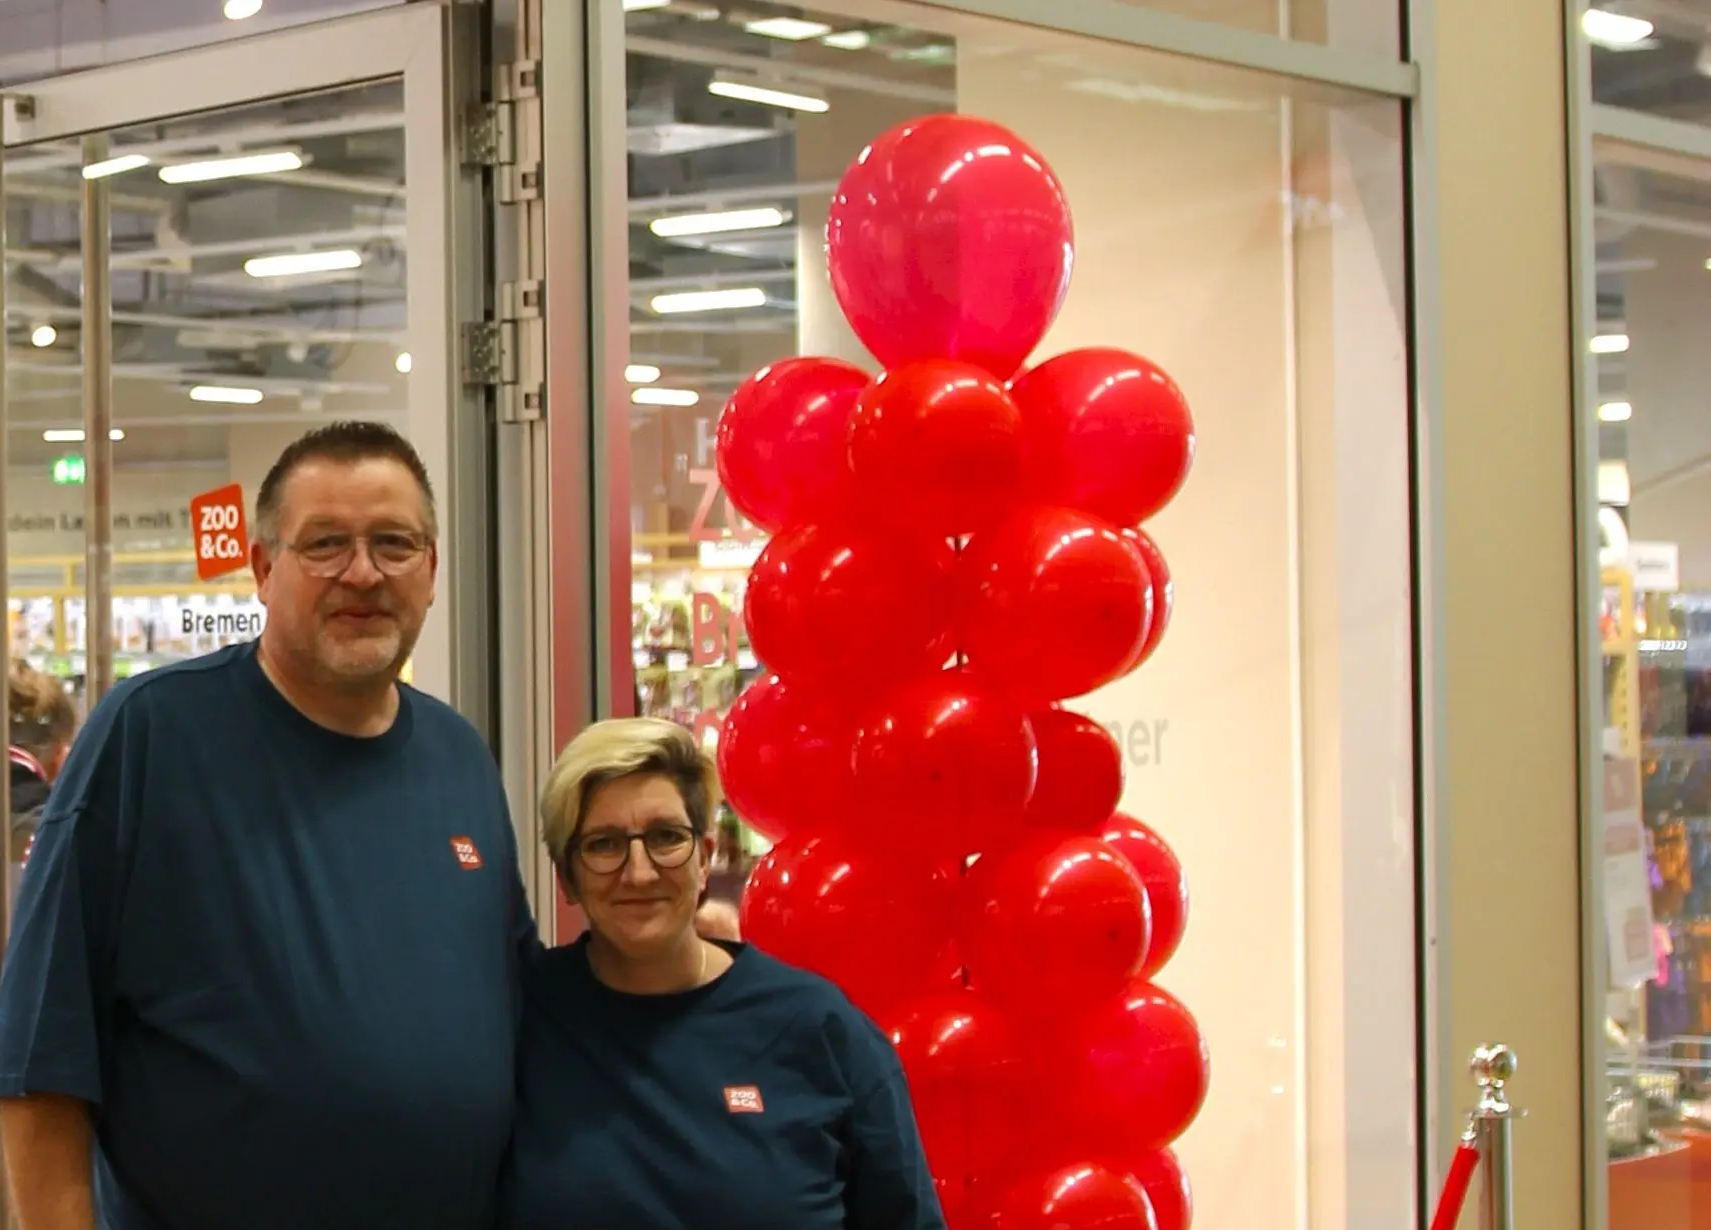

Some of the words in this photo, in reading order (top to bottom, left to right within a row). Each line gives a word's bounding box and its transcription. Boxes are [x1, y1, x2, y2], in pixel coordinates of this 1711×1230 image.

[200, 504, 240, 532] ZOO
[200, 533, 243, 560] &Co.
[181, 607, 262, 635] Bremen
